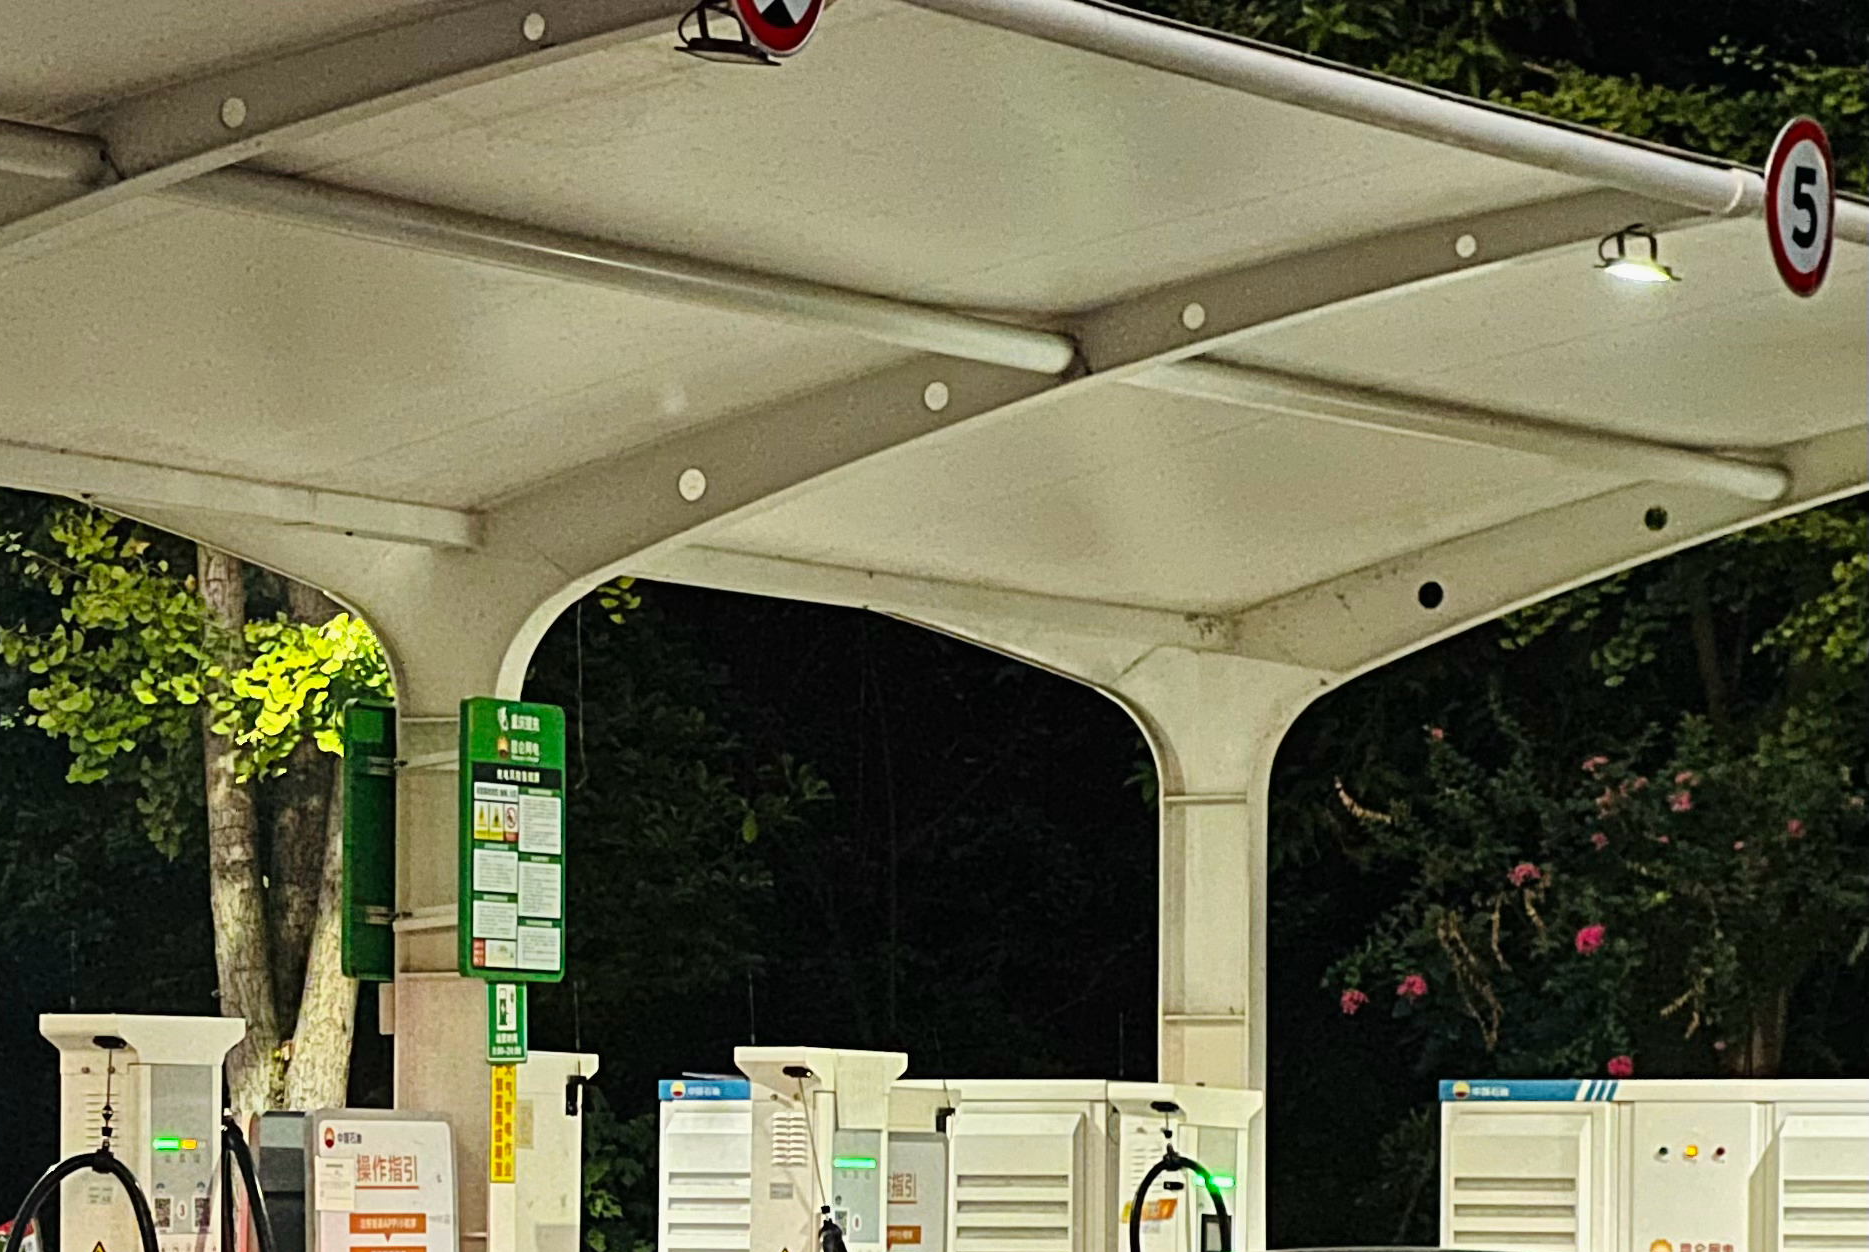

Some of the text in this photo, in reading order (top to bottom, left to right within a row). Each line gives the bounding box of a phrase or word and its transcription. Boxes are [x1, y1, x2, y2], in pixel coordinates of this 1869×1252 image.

[1792, 166, 1817, 249] 5
[357, 1154, 418, 1182] 操作指引
